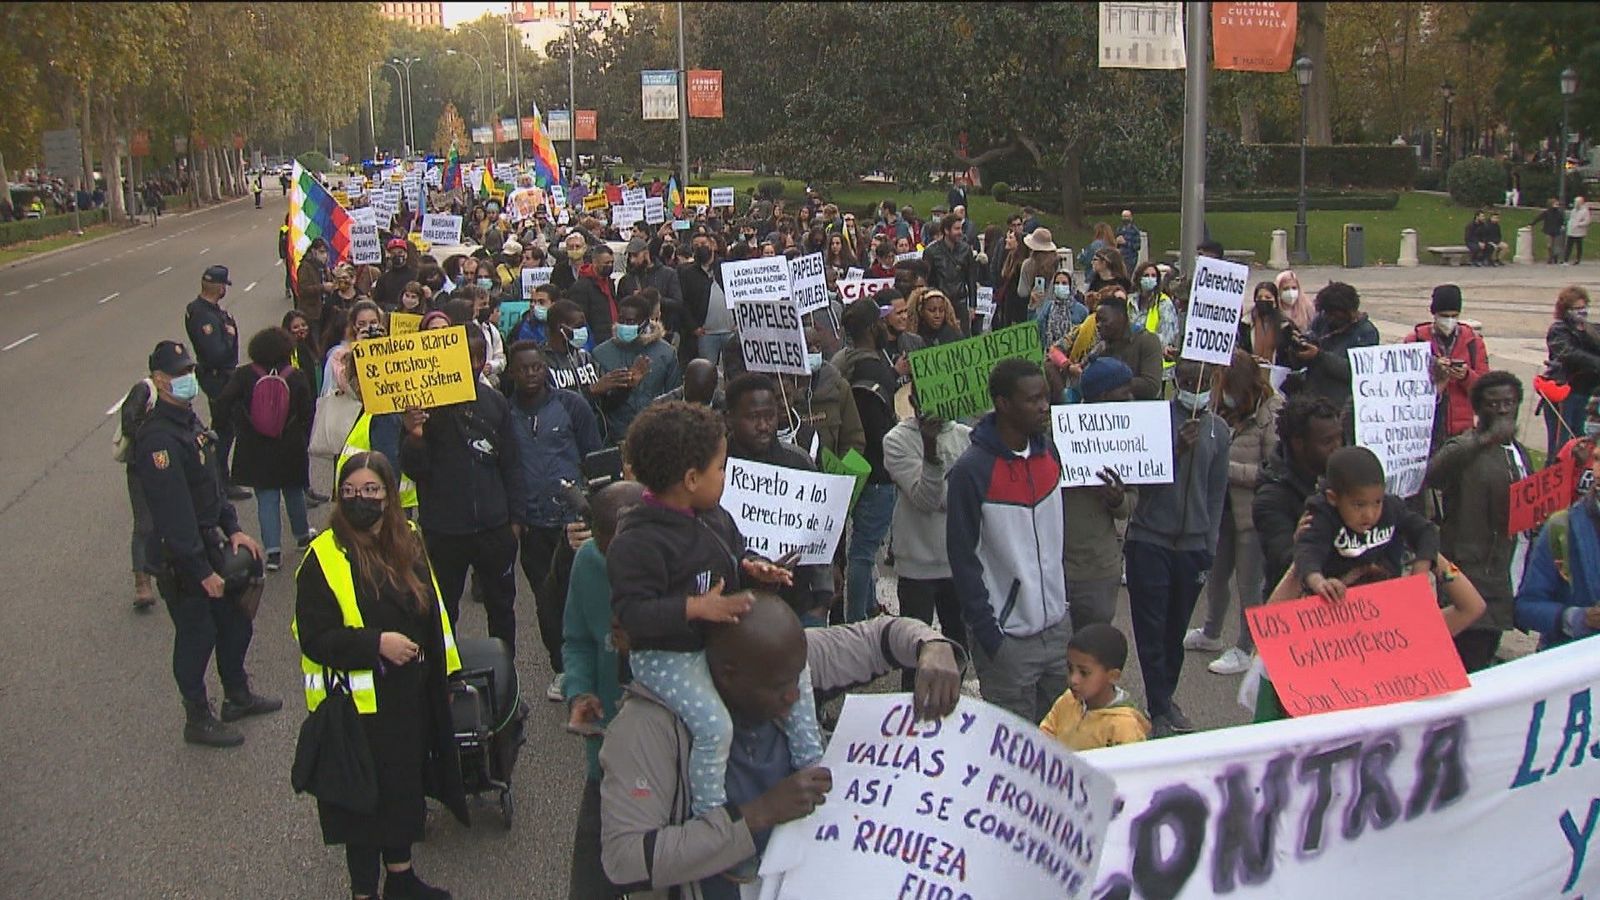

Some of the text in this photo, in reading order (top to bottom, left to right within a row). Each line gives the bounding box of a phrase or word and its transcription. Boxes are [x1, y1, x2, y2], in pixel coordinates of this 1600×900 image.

[1220, 16, 1287, 29] DE LA VILLA
[1228, 8, 1281, 18] CULTURAL
[1191, 296, 1238, 324] humanos
[1186, 327, 1235, 354] a TODOS!
[912, 342, 983, 380] EXIGIMOS
[806, 513, 820, 532] de
[846, 741, 946, 779] VALLAS
[916, 790, 955, 822] SE
[1091, 714, 1470, 900] ONTRA
[815, 818, 970, 883] LA RIQUEZA
